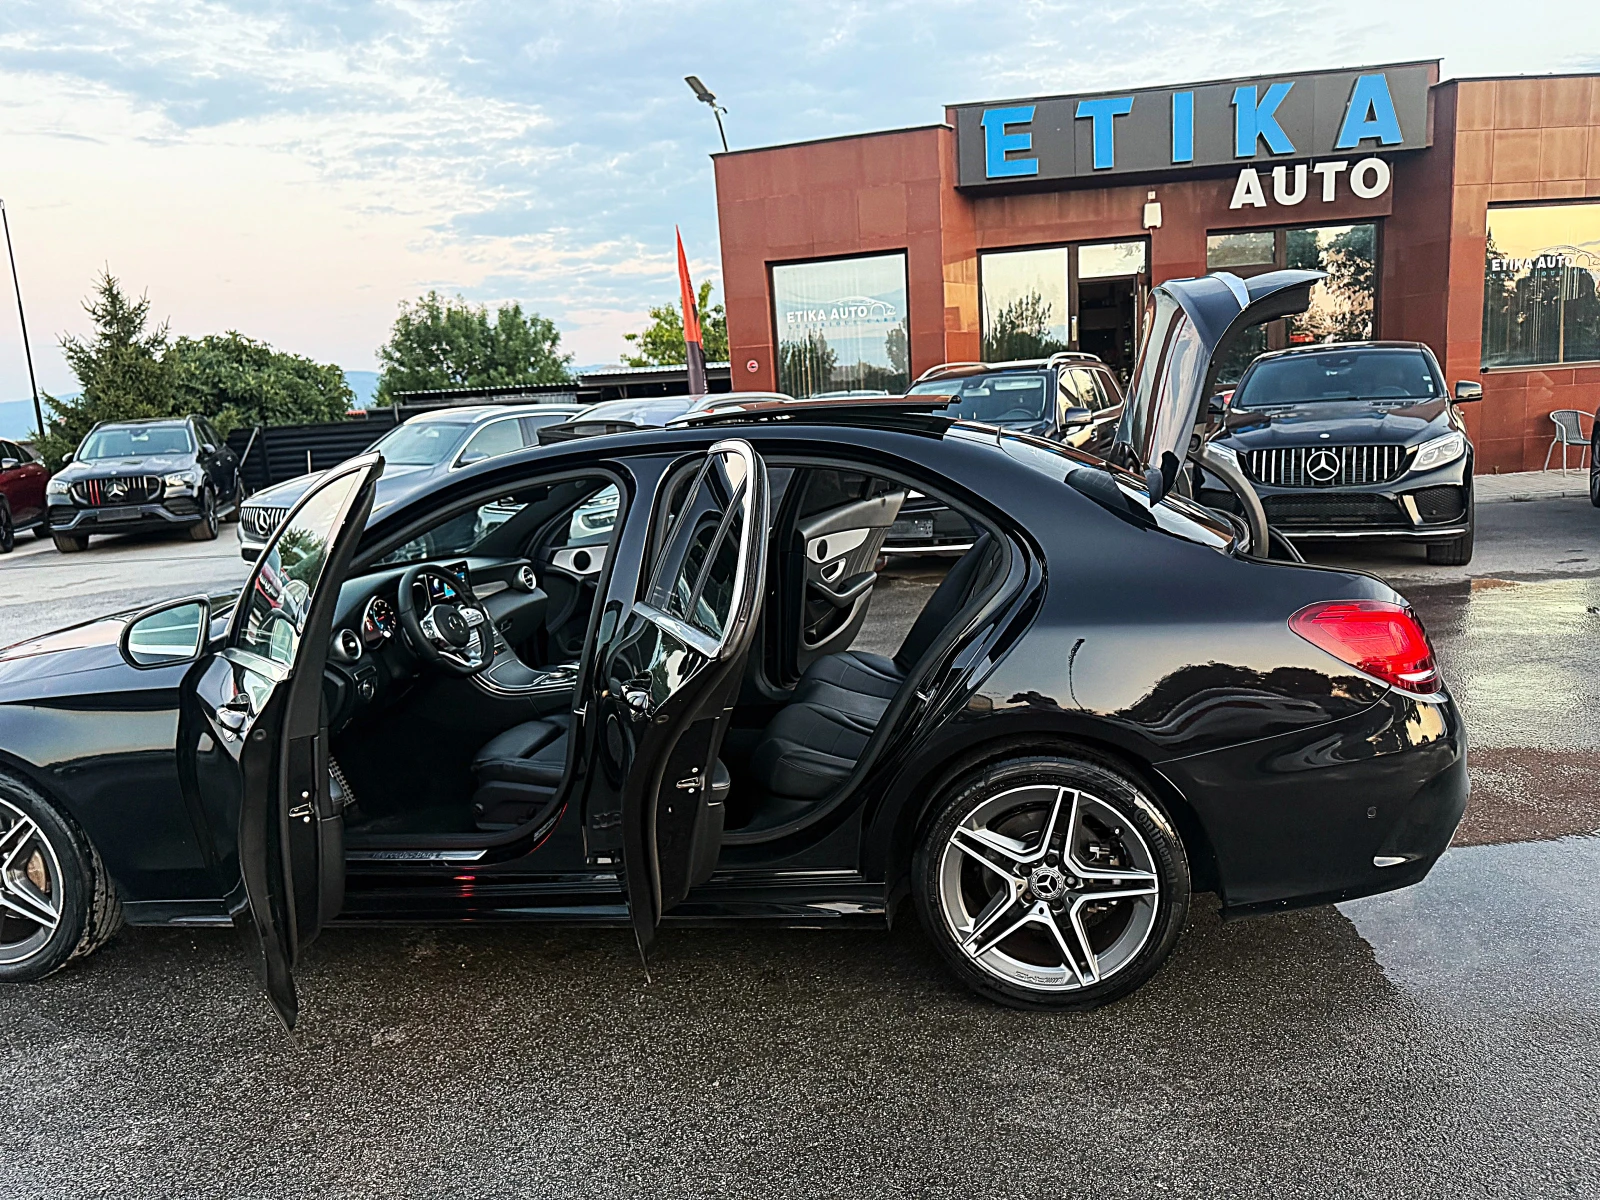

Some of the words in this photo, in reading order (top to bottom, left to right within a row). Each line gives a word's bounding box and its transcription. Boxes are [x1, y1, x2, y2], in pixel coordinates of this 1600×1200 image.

[980, 73, 1403, 179] ETIKA
[1229, 158, 1391, 209] AUTO
[1491, 259, 1533, 272] ETIKA
[1537, 256, 1574, 269] AUTO
[786, 309, 827, 323] ETIKA
[830, 306, 868, 320] AUTO
